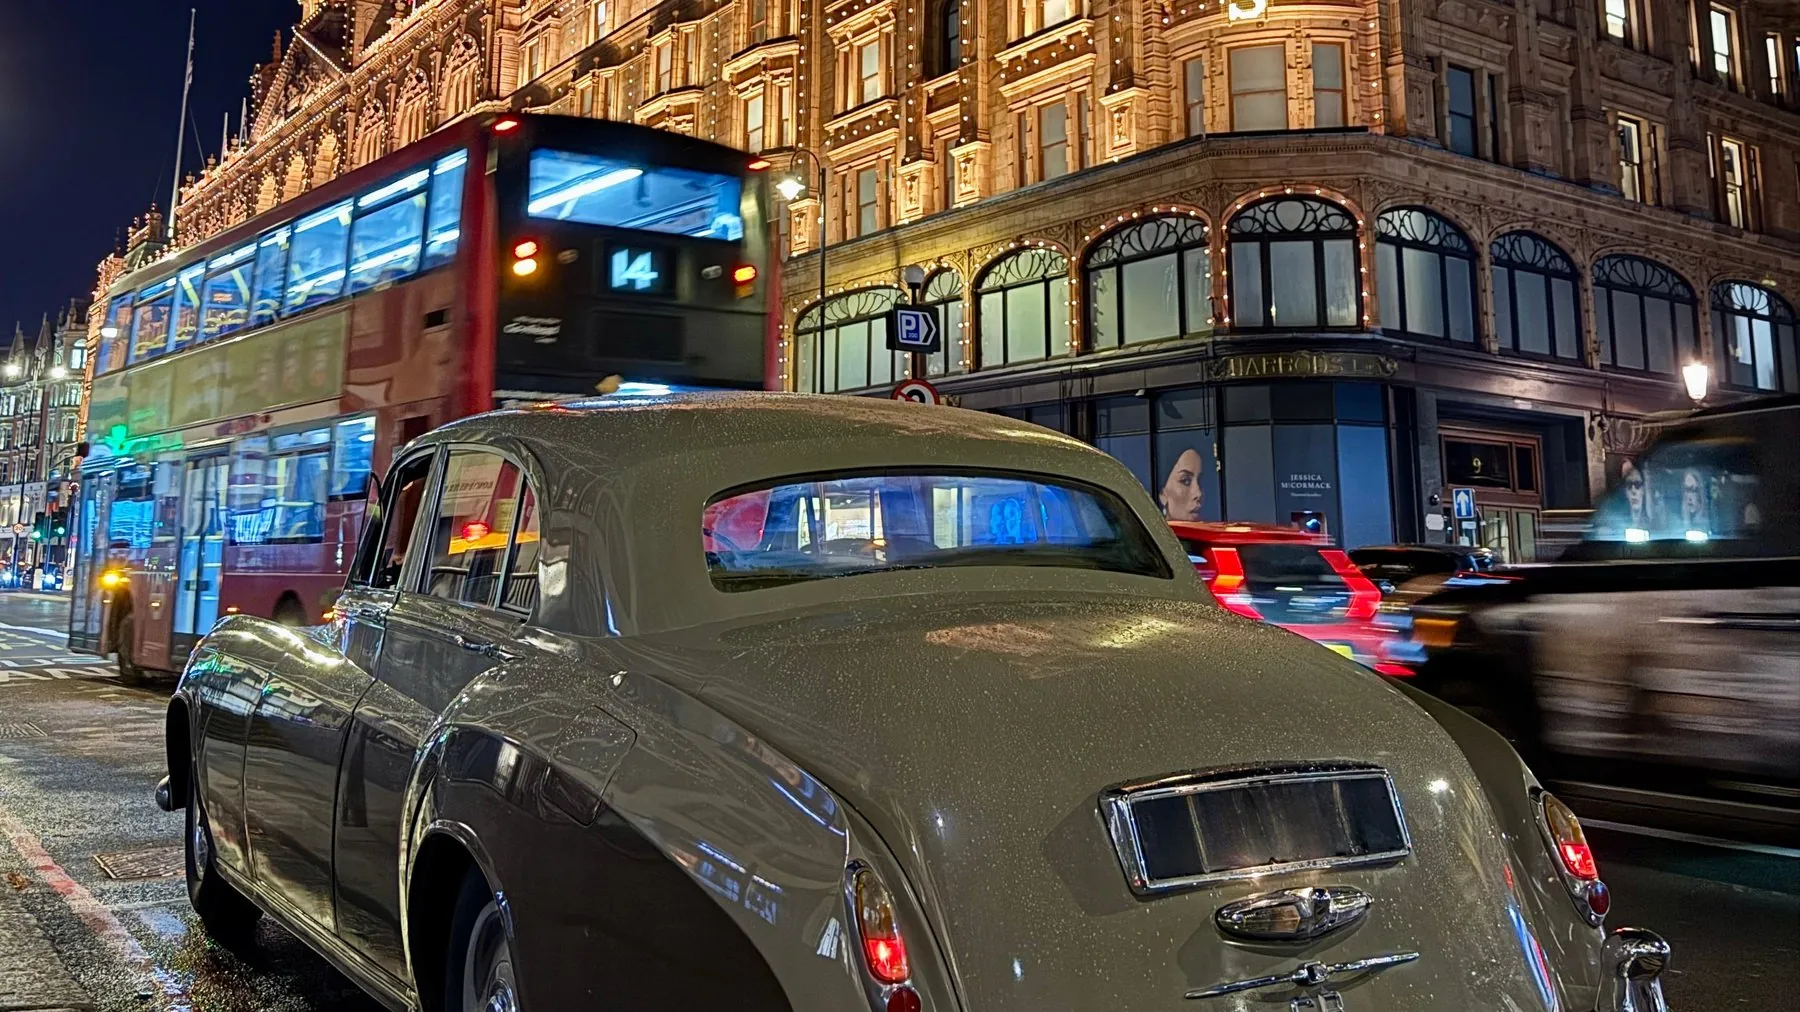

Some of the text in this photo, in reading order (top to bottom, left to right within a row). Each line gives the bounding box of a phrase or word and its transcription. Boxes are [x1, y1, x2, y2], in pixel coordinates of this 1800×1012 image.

[612, 249, 658, 290] 14
[901, 315, 917, 339] P
[1229, 357, 1344, 376] HARRODS
[1473, 458, 1481, 473] 9
